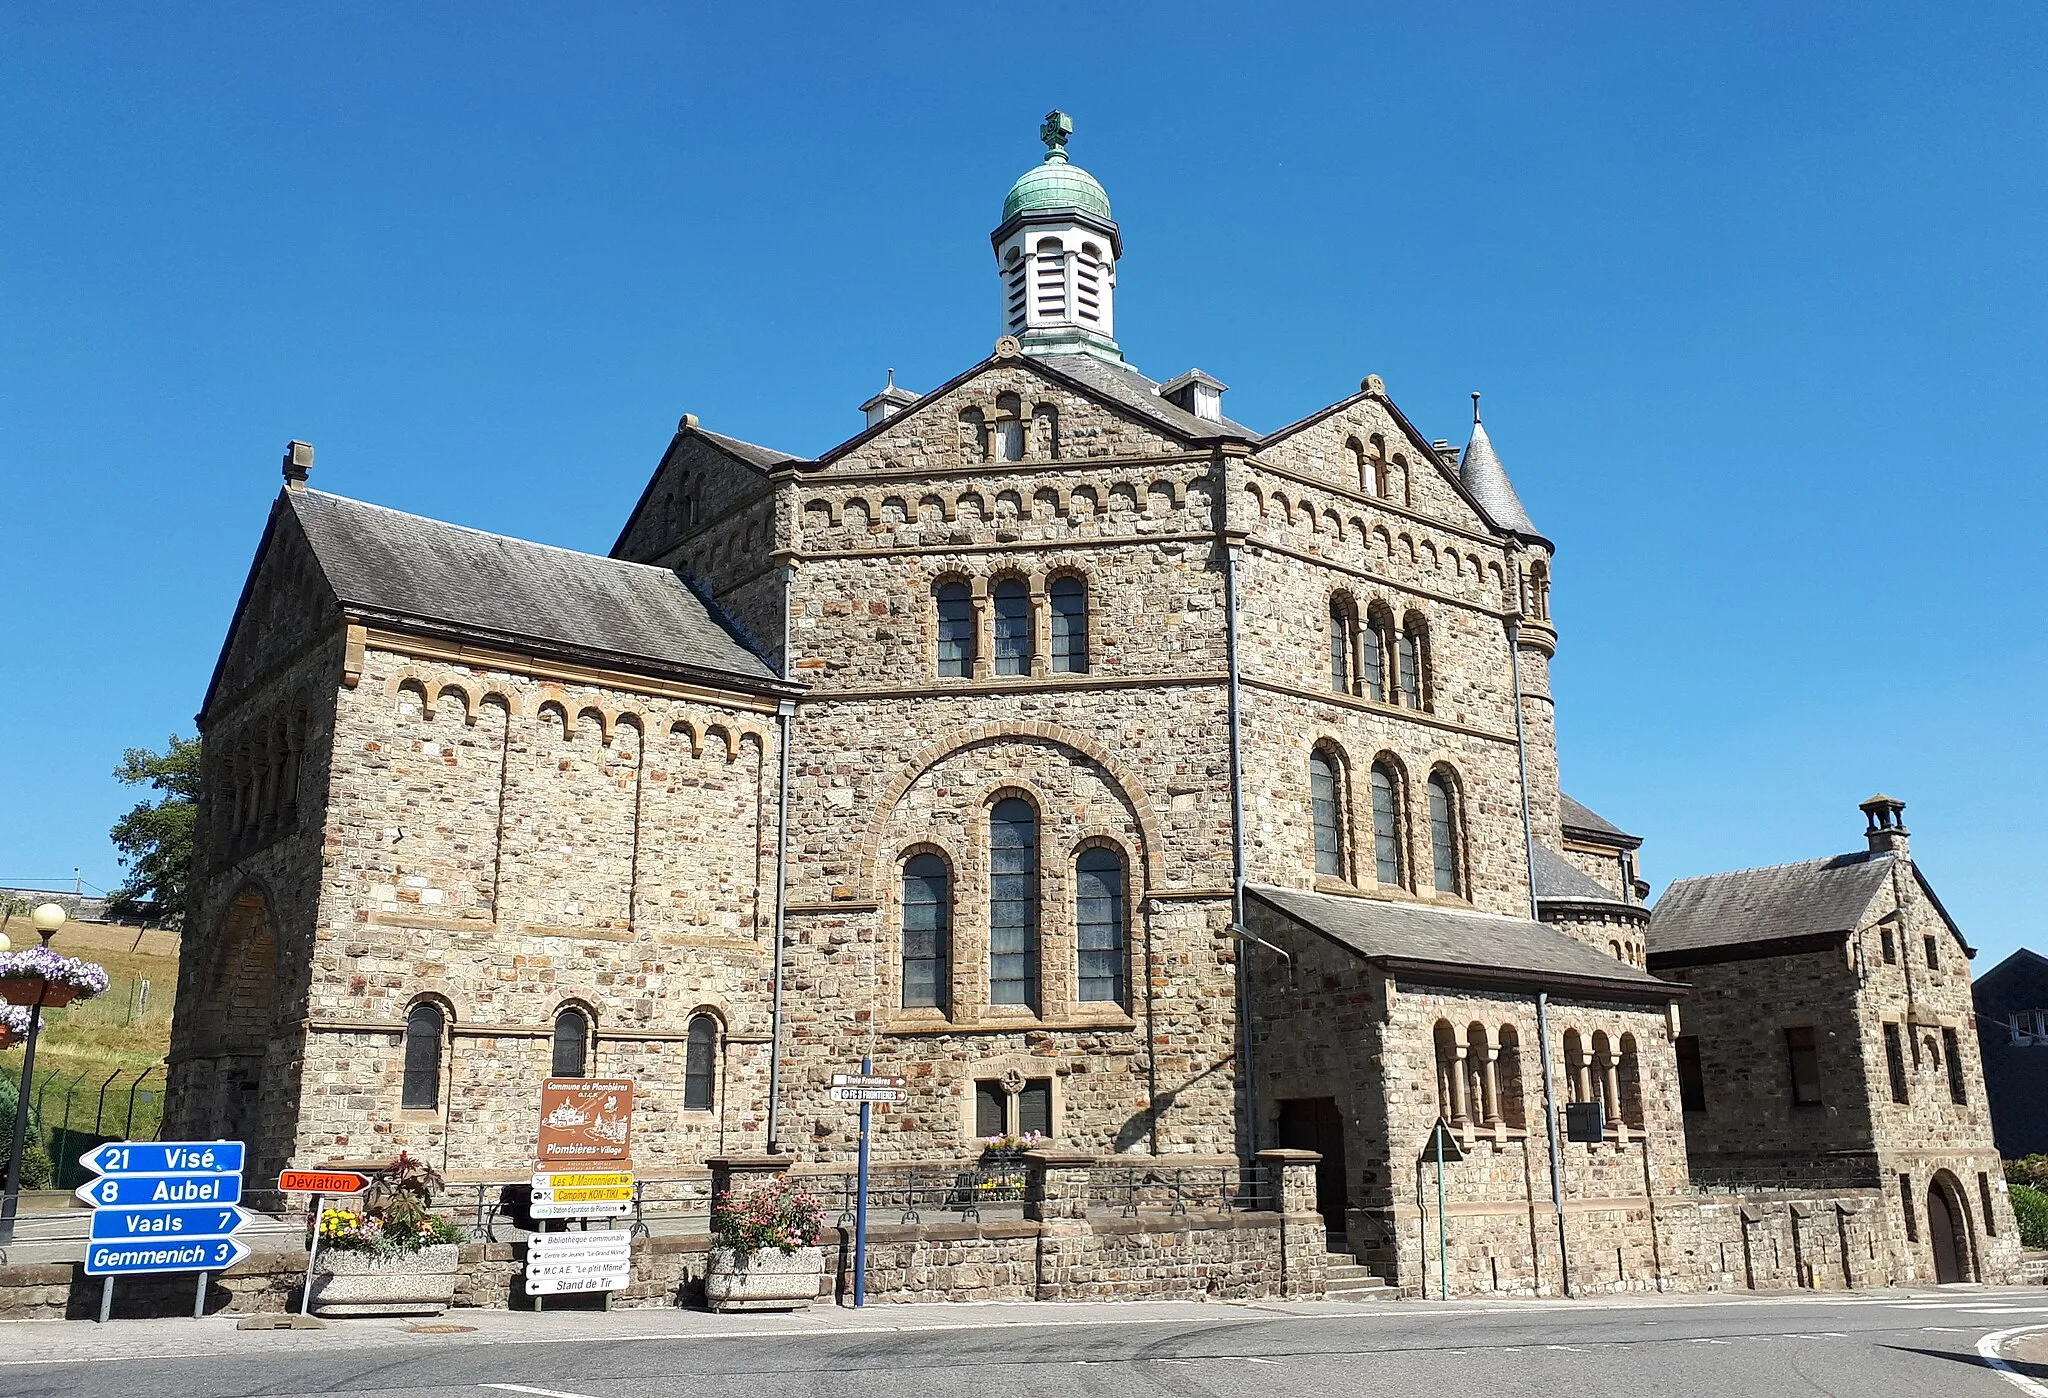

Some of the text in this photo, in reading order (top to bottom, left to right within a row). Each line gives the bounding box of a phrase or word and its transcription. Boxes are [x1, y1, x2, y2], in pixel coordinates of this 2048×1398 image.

[547, 1082, 628, 1092] Commune de Plombières
[850, 1090, 858, 1099] FC
[104, 1148, 214, 1170] 21 Visé
[286, 1174, 350, 1190] Déviation
[552, 1176, 566, 1186] Les
[569, 1176, 575, 1186] 3
[102, 1180, 220, 1202] 8 Aubel
[558, 1189, 619, 1201] Camping KON-TIKI
[126, 1212, 232, 1232] Vaals 7
[548, 1234, 624, 1244] Bibliothèque communale
[94, 1244, 229, 1266] Gemmenich 3
[544, 1263, 626, 1275] M.C.A.E. "Le p'tit Môme"
[556, 1278, 612, 1290] Stand de Tir
